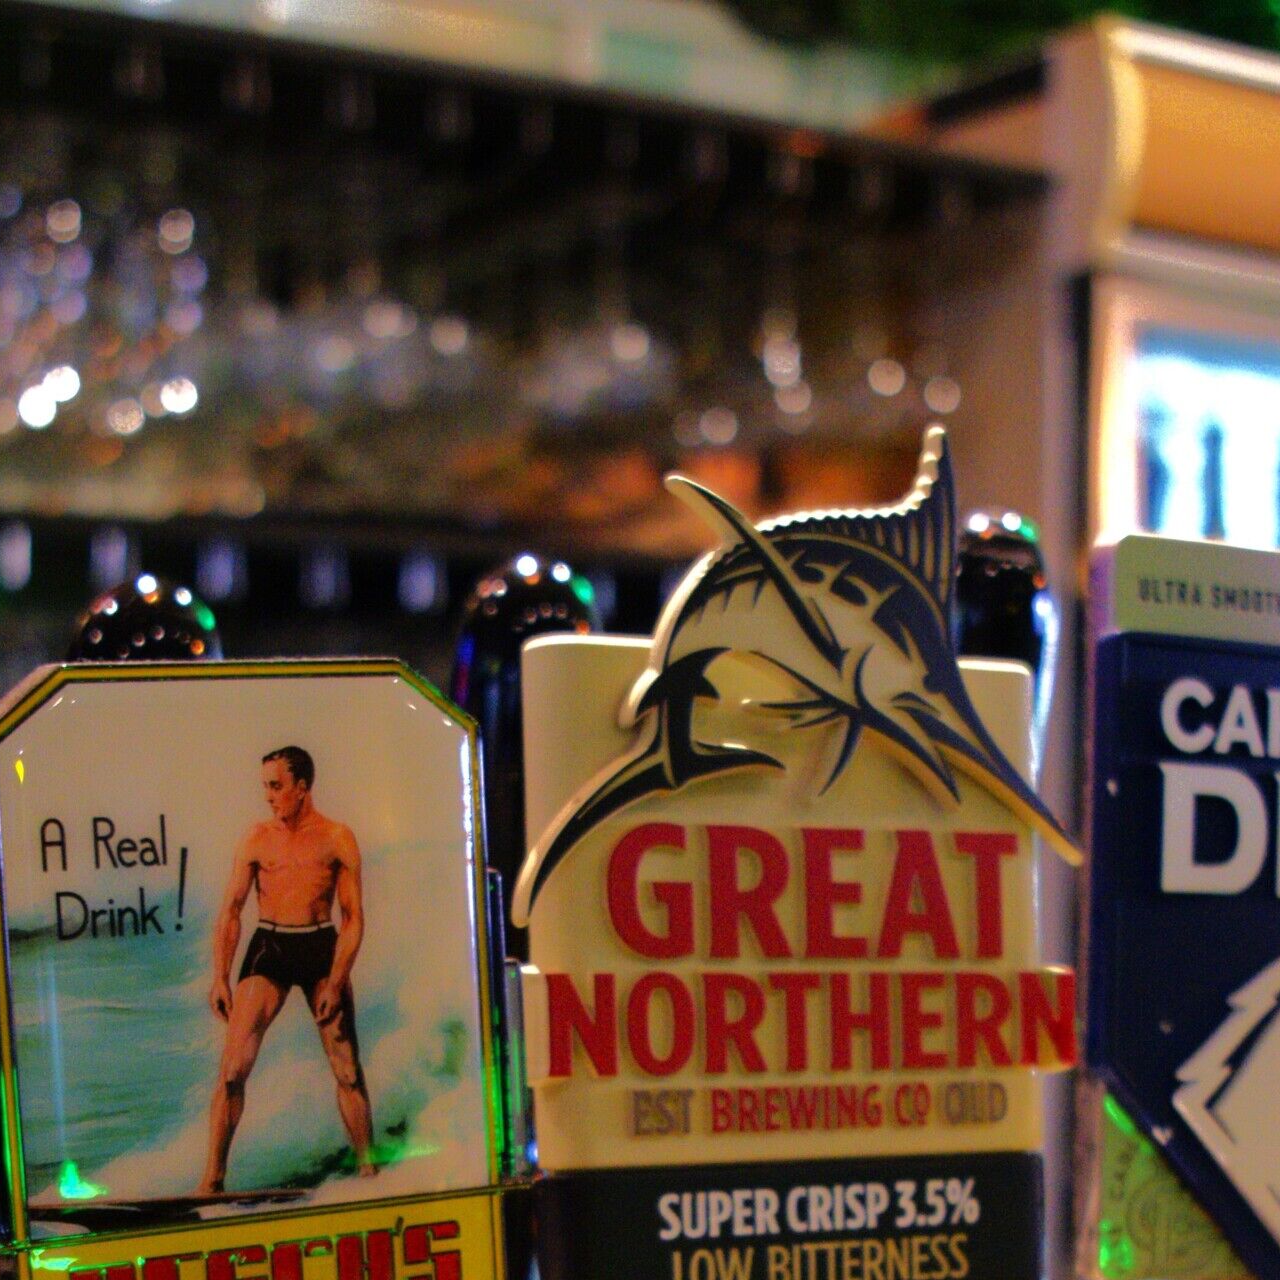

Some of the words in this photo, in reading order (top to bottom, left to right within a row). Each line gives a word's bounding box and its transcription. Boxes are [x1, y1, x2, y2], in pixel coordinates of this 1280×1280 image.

[1138, 577, 1202, 606] ULTRA
[40, 818, 70, 872] A
[91, 814, 168, 868] Real
[606, 821, 1018, 961] GREAT
[546, 970, 1077, 1079] NORTHERN
[632, 1087, 695, 1136] EST
[710, 1082, 884, 1134] BREWING
[944, 1080, 1009, 1124] QLD
[658, 1191, 780, 1241] SUPER
[786, 1184, 889, 1234] CRISP
[894, 1176, 981, 1228] 3.5%
